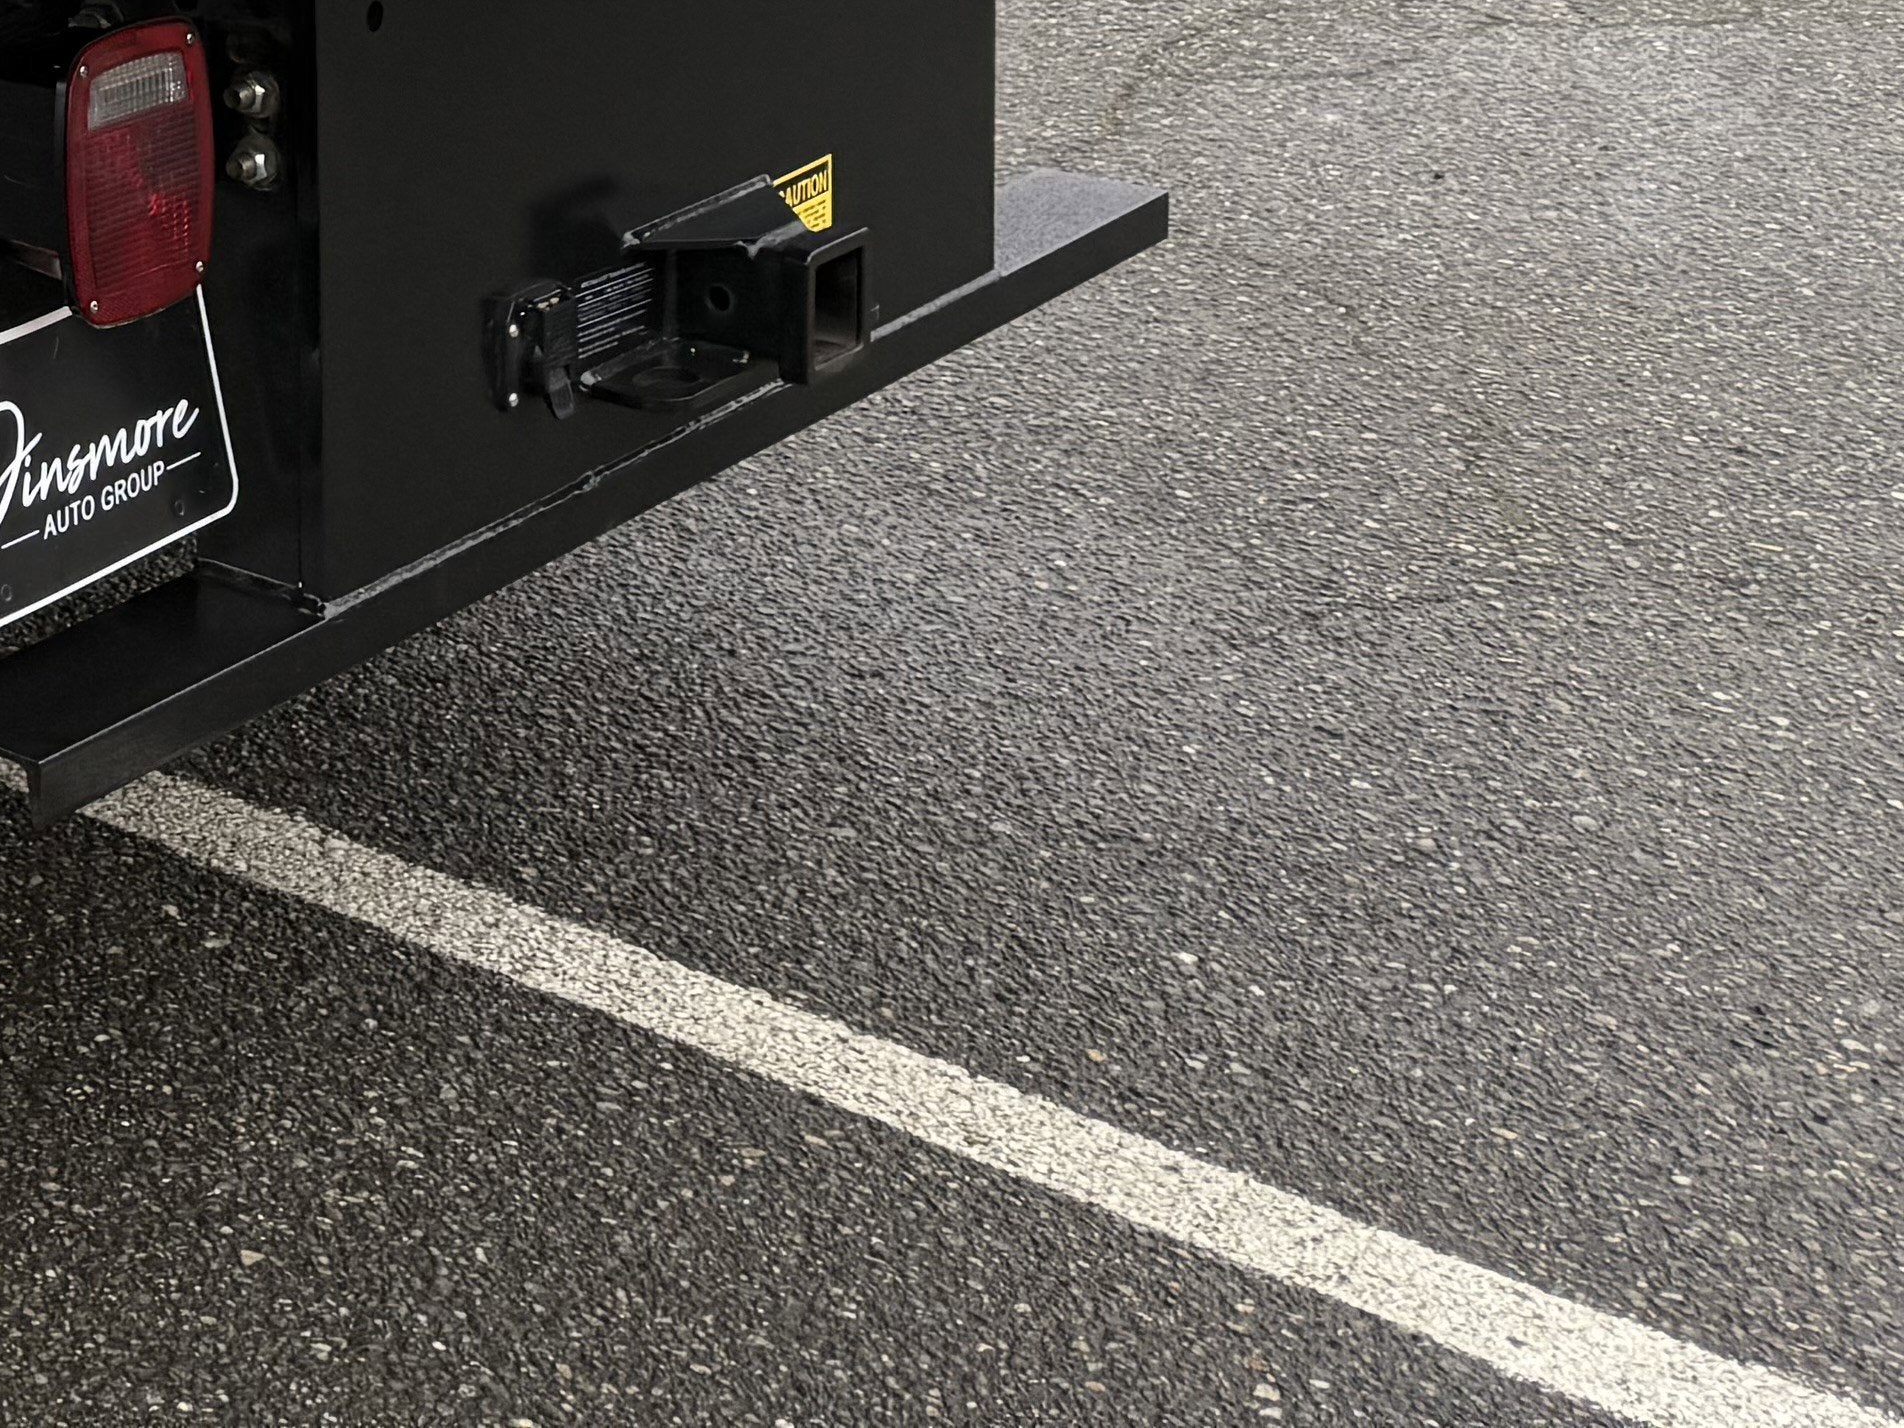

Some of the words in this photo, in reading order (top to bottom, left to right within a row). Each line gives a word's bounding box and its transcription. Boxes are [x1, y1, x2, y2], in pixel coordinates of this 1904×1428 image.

[778, 169, 828, 207] AUTION
[43, 495, 95, 540] AUTO
[100, 460, 166, 511] GROUP
